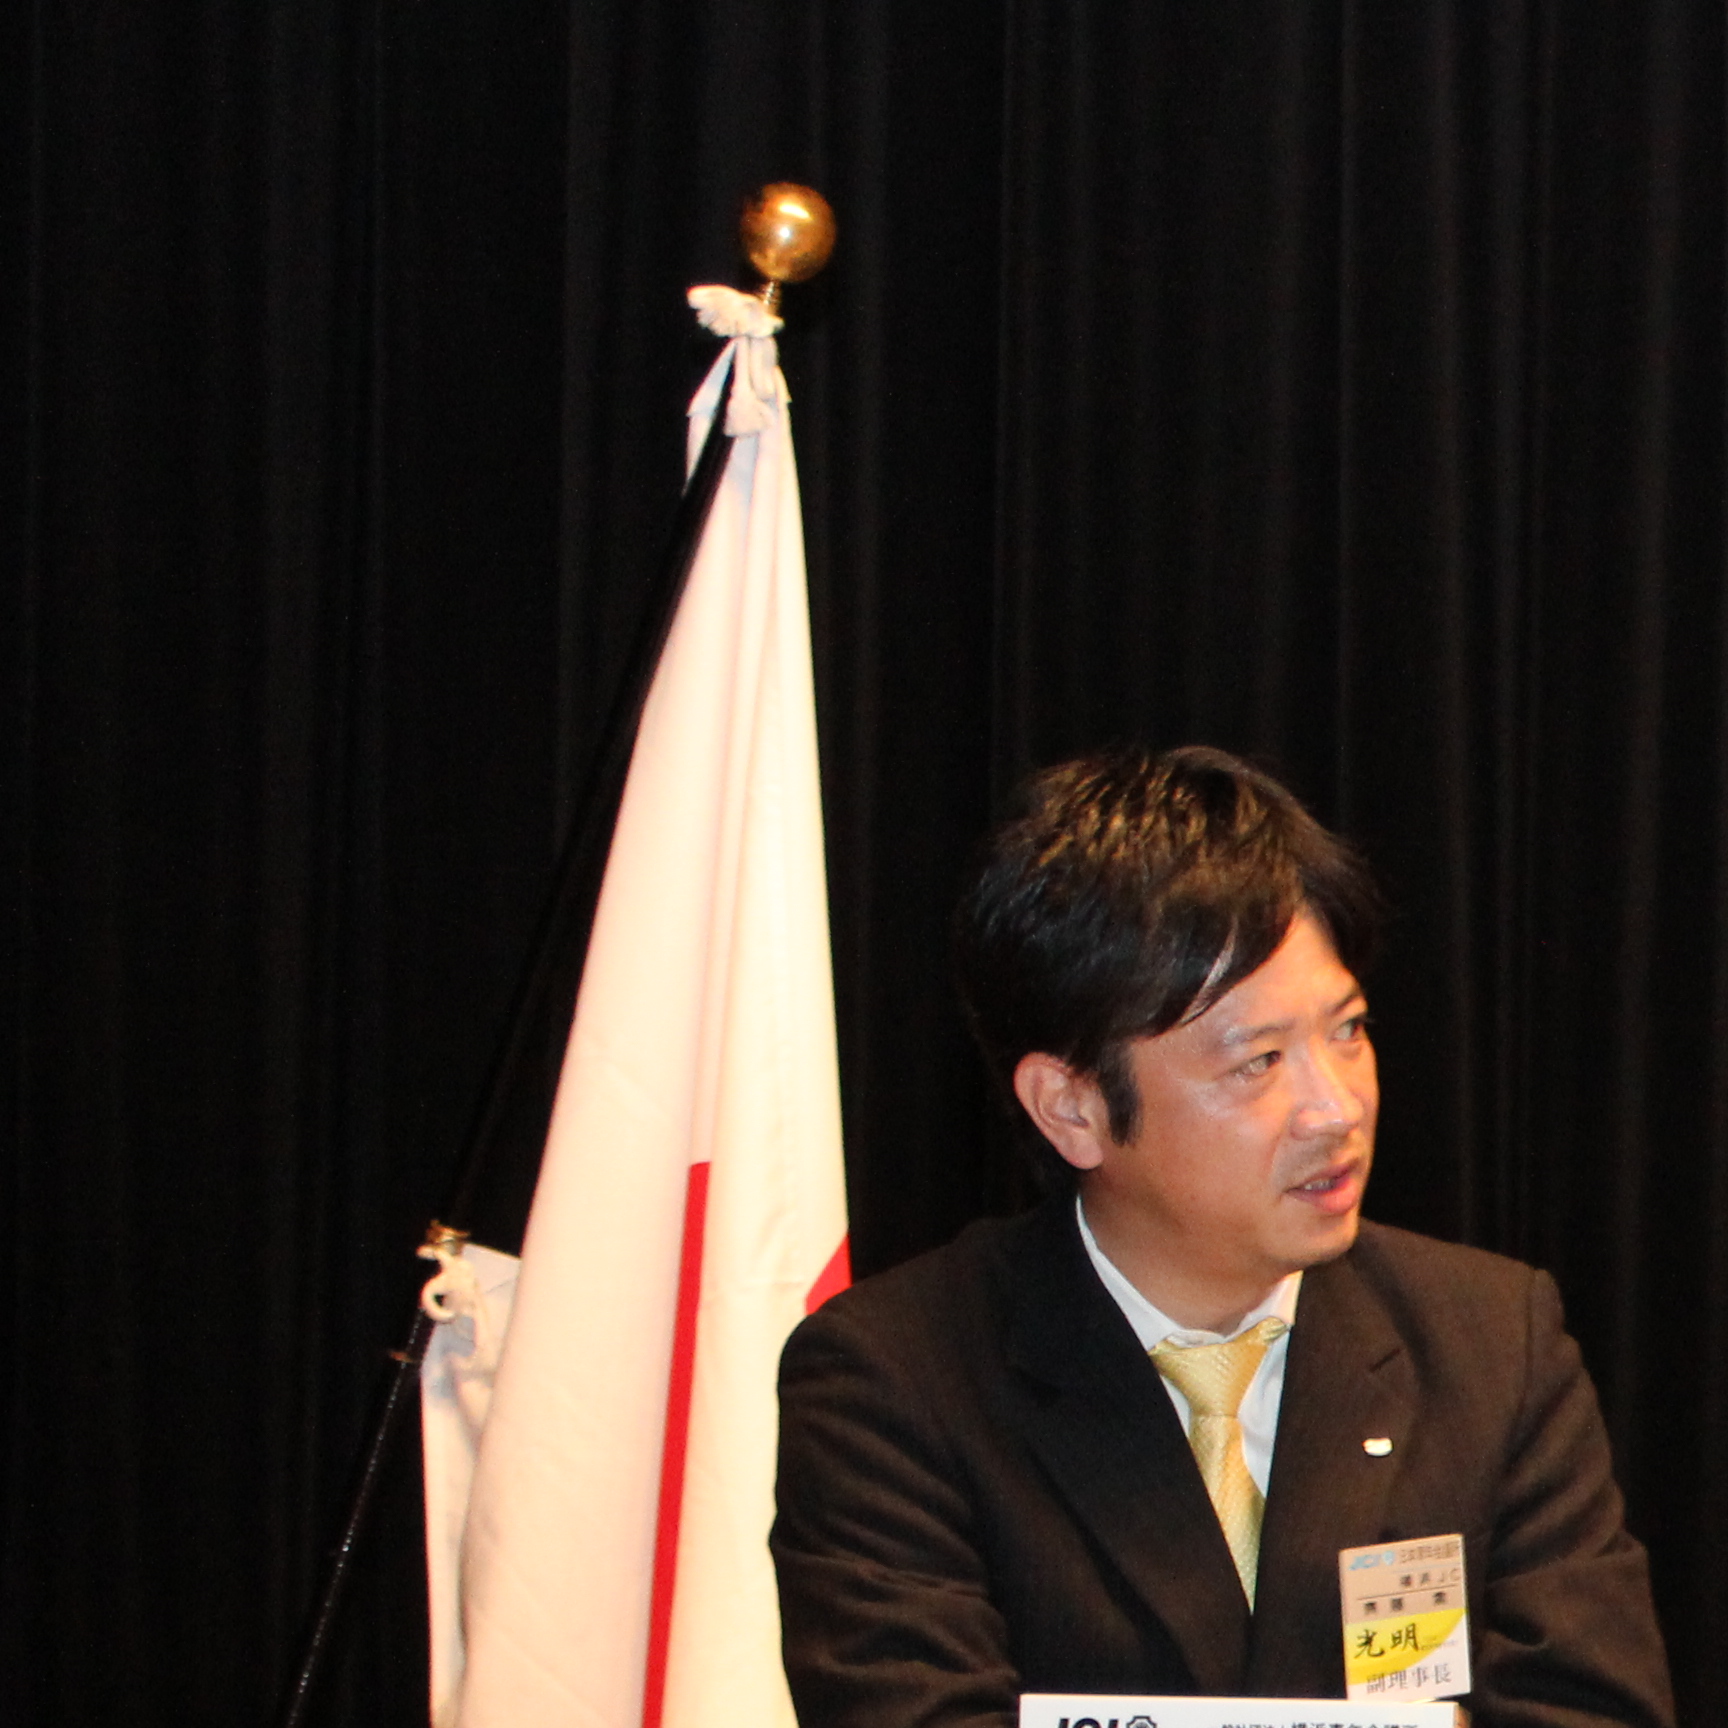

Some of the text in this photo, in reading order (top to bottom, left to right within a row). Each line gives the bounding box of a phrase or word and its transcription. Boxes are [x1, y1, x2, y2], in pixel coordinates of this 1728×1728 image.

[1354, 1623, 1419, 1660] 光明
[1366, 1662, 1452, 1694] 副理事長
